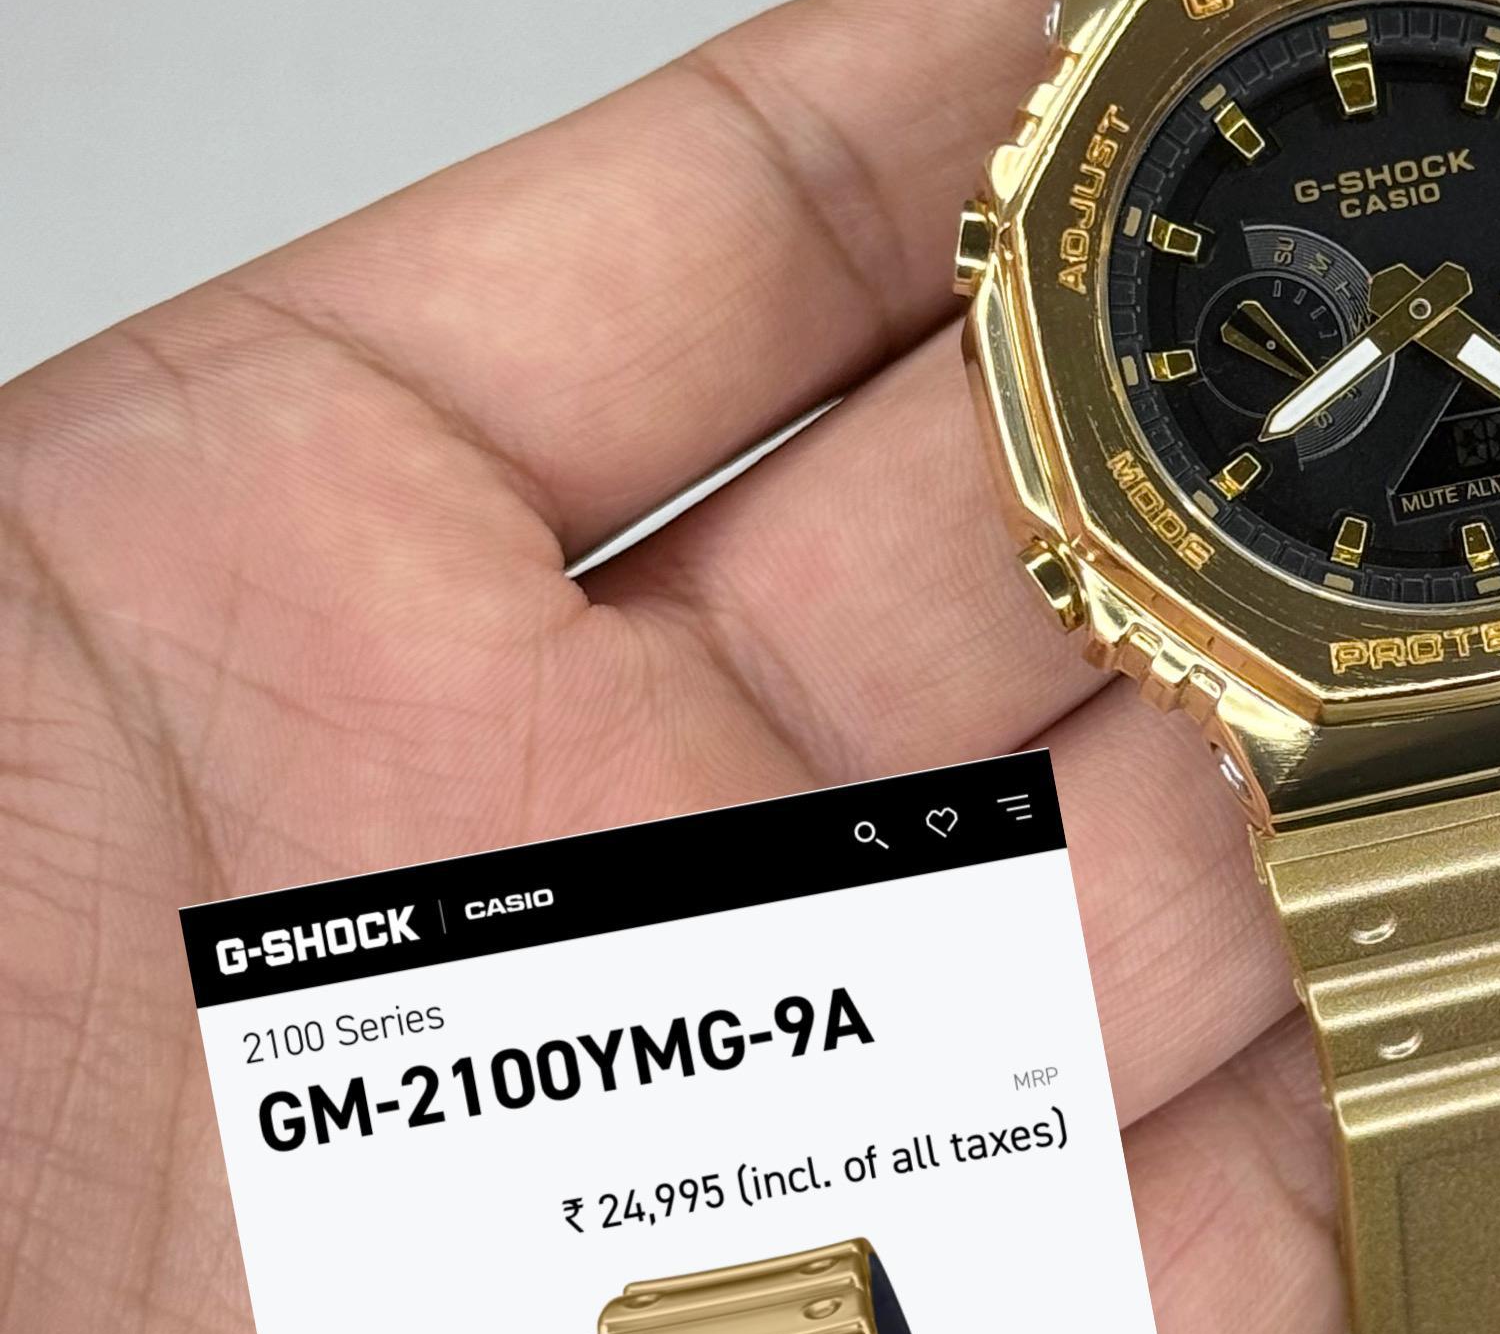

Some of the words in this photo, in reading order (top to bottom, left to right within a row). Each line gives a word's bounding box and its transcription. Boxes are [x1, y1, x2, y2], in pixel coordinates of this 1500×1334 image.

[1294, 148, 1475, 203] G-SHOCK
[1057, 104, 1131, 294] ADJUST
[1340, 183, 1440, 218] CASIO
[1274, 236, 1295, 265] SU
[1108, 450, 1216, 570] MODE
[1402, 488, 1458, 513] MUTE
